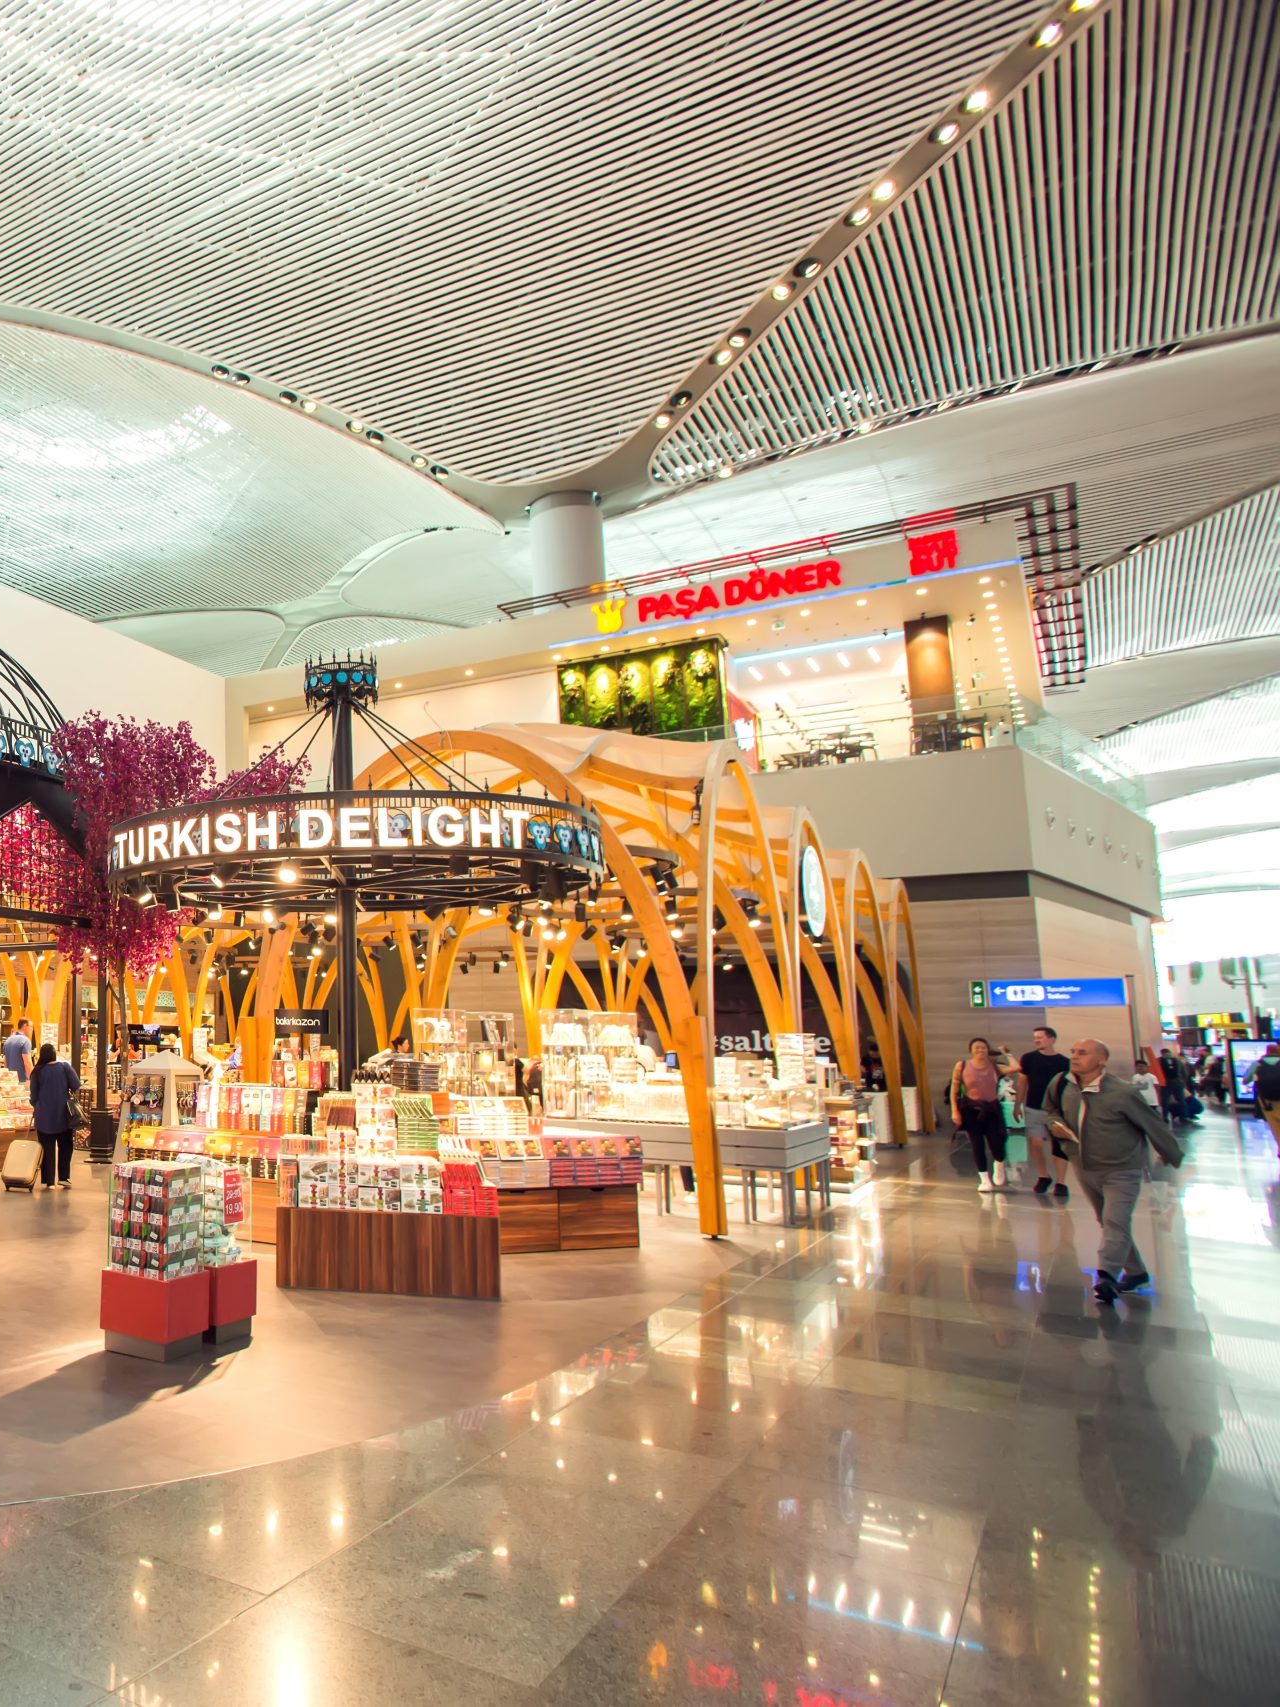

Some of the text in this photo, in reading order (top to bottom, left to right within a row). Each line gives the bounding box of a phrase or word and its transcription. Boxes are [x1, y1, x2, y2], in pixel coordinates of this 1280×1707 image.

[638, 560, 842, 622] PAŞA DÖNER
[114, 806, 531, 866] TURKISH DELIGHT
[714, 1030, 832, 1053] salte
